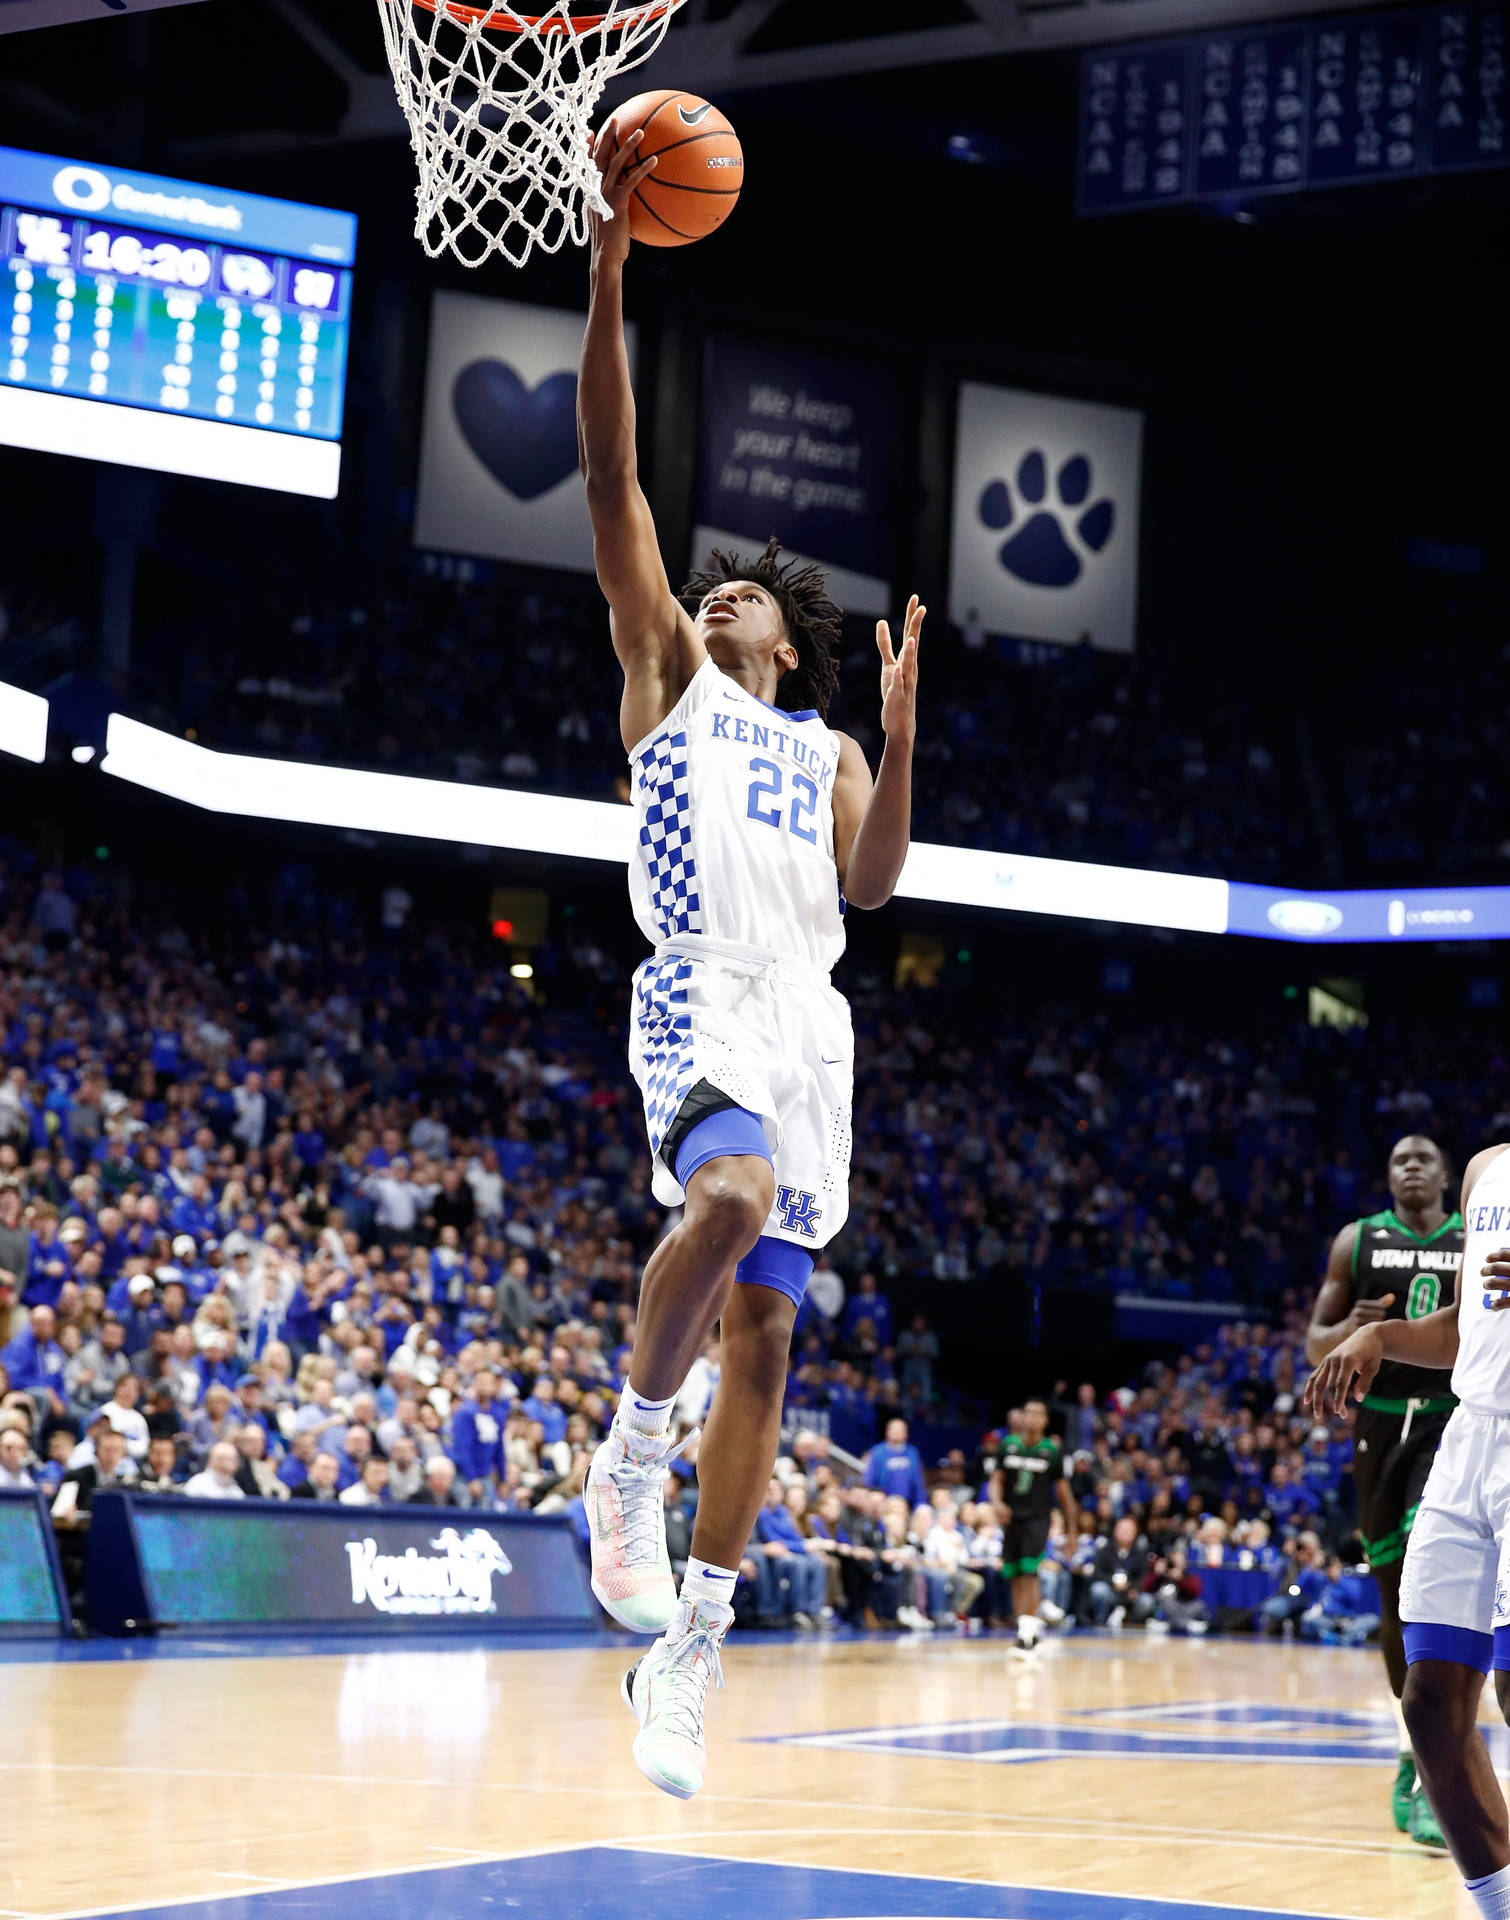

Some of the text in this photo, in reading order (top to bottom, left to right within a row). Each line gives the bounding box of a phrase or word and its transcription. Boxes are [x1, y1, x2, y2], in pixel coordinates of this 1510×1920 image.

[1314, 31, 1347, 148] NCAA
[1437, 12, 1468, 128] NCAA
[1088, 60, 1117, 175] NCAA
[1200, 41, 1233, 157] NCAA
[749, 384, 853, 433] We keep
[731, 429, 861, 472] your heart
[720, 464, 866, 512] in the game
[747, 757, 818, 846] 22
[777, 1185, 822, 1238] UK
[1371, 1249, 1416, 1269] UTAH
[1405, 1272, 1441, 1320] 0
